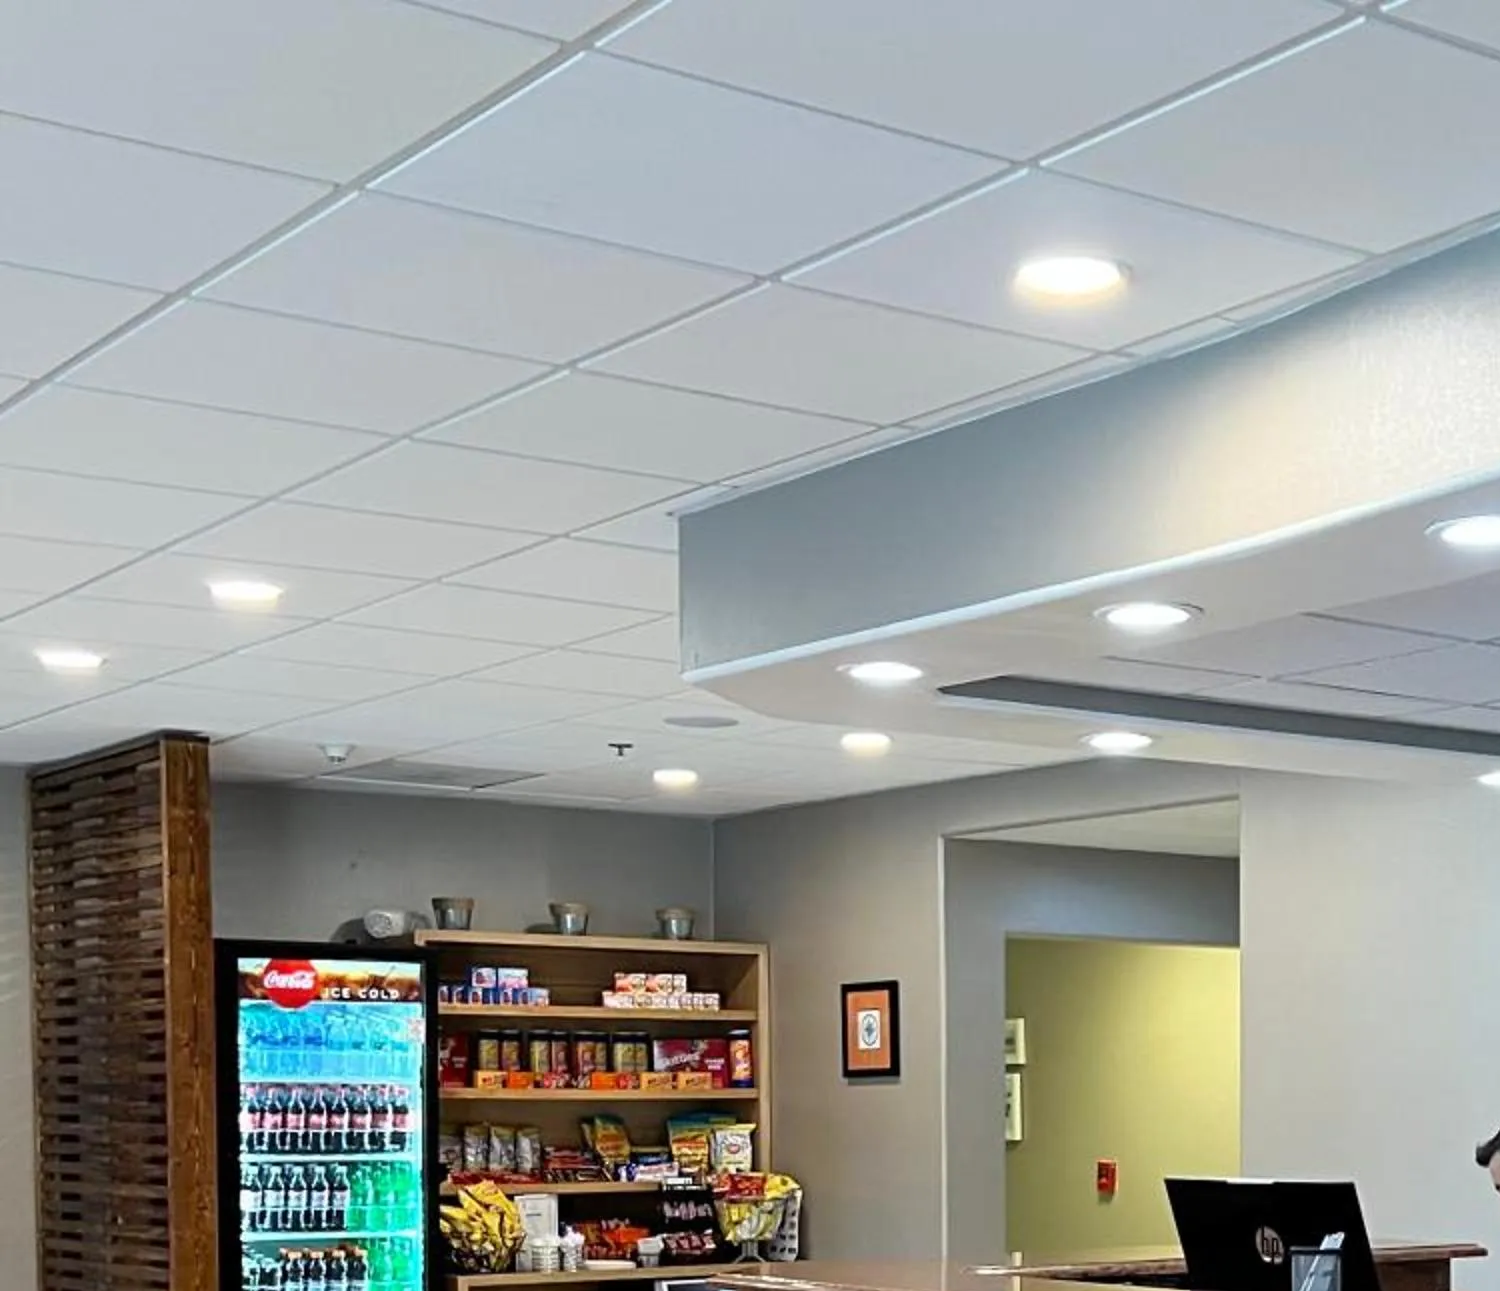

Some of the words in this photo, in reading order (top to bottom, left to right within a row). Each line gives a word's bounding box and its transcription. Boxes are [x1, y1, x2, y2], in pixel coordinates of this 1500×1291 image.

[320, 987, 351, 999] ICE
[358, 988, 400, 999] COLD
[1259, 1225, 1282, 1264] hp
